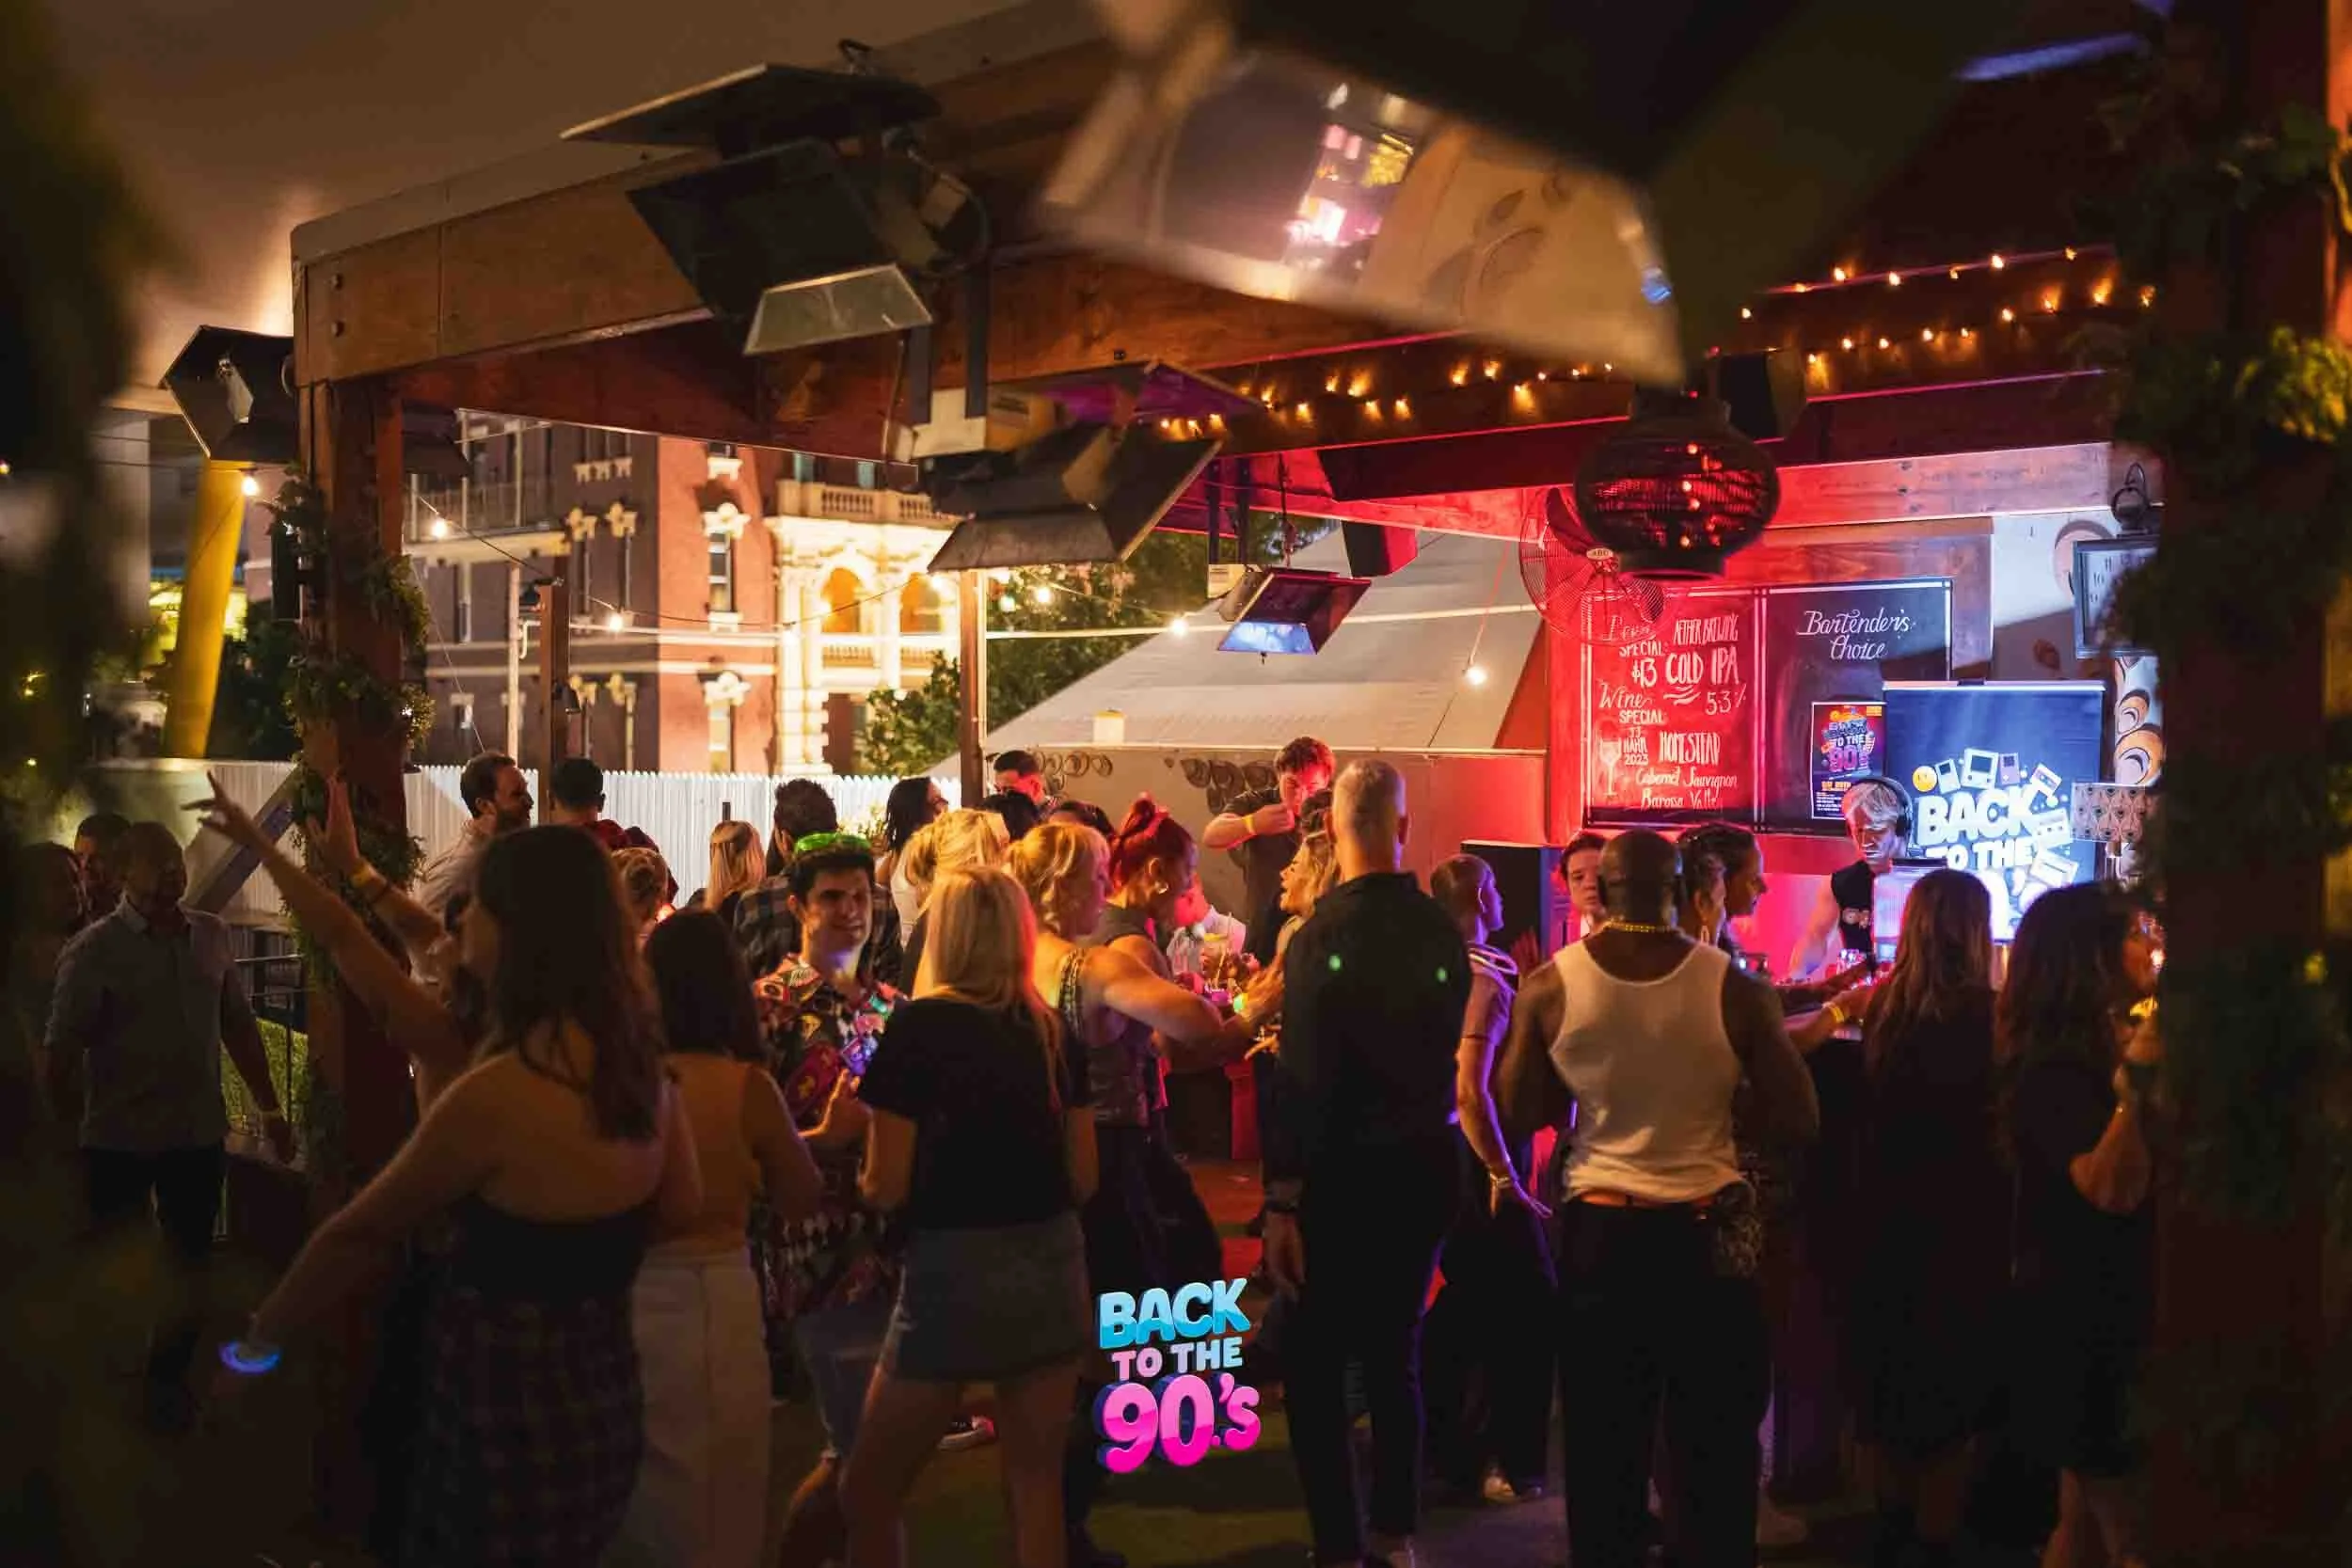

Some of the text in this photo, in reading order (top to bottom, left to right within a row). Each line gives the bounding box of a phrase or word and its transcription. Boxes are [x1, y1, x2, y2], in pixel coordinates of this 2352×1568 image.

[1830, 634, 1886, 660] Choice
[1631, 658, 1659, 689] $13
[1665, 645, 1740, 685] COLD IPA
[1597, 680, 1652, 708] Wine
[1846, 734, 1867, 746] THE
[1625, 752, 1649, 766] 2023
[1683, 767, 1738, 799] Sauvignon
[1640, 787, 1684, 812] Barossa
[1915, 784, 2039, 846] BACK
[1972, 835, 2036, 870] THE
